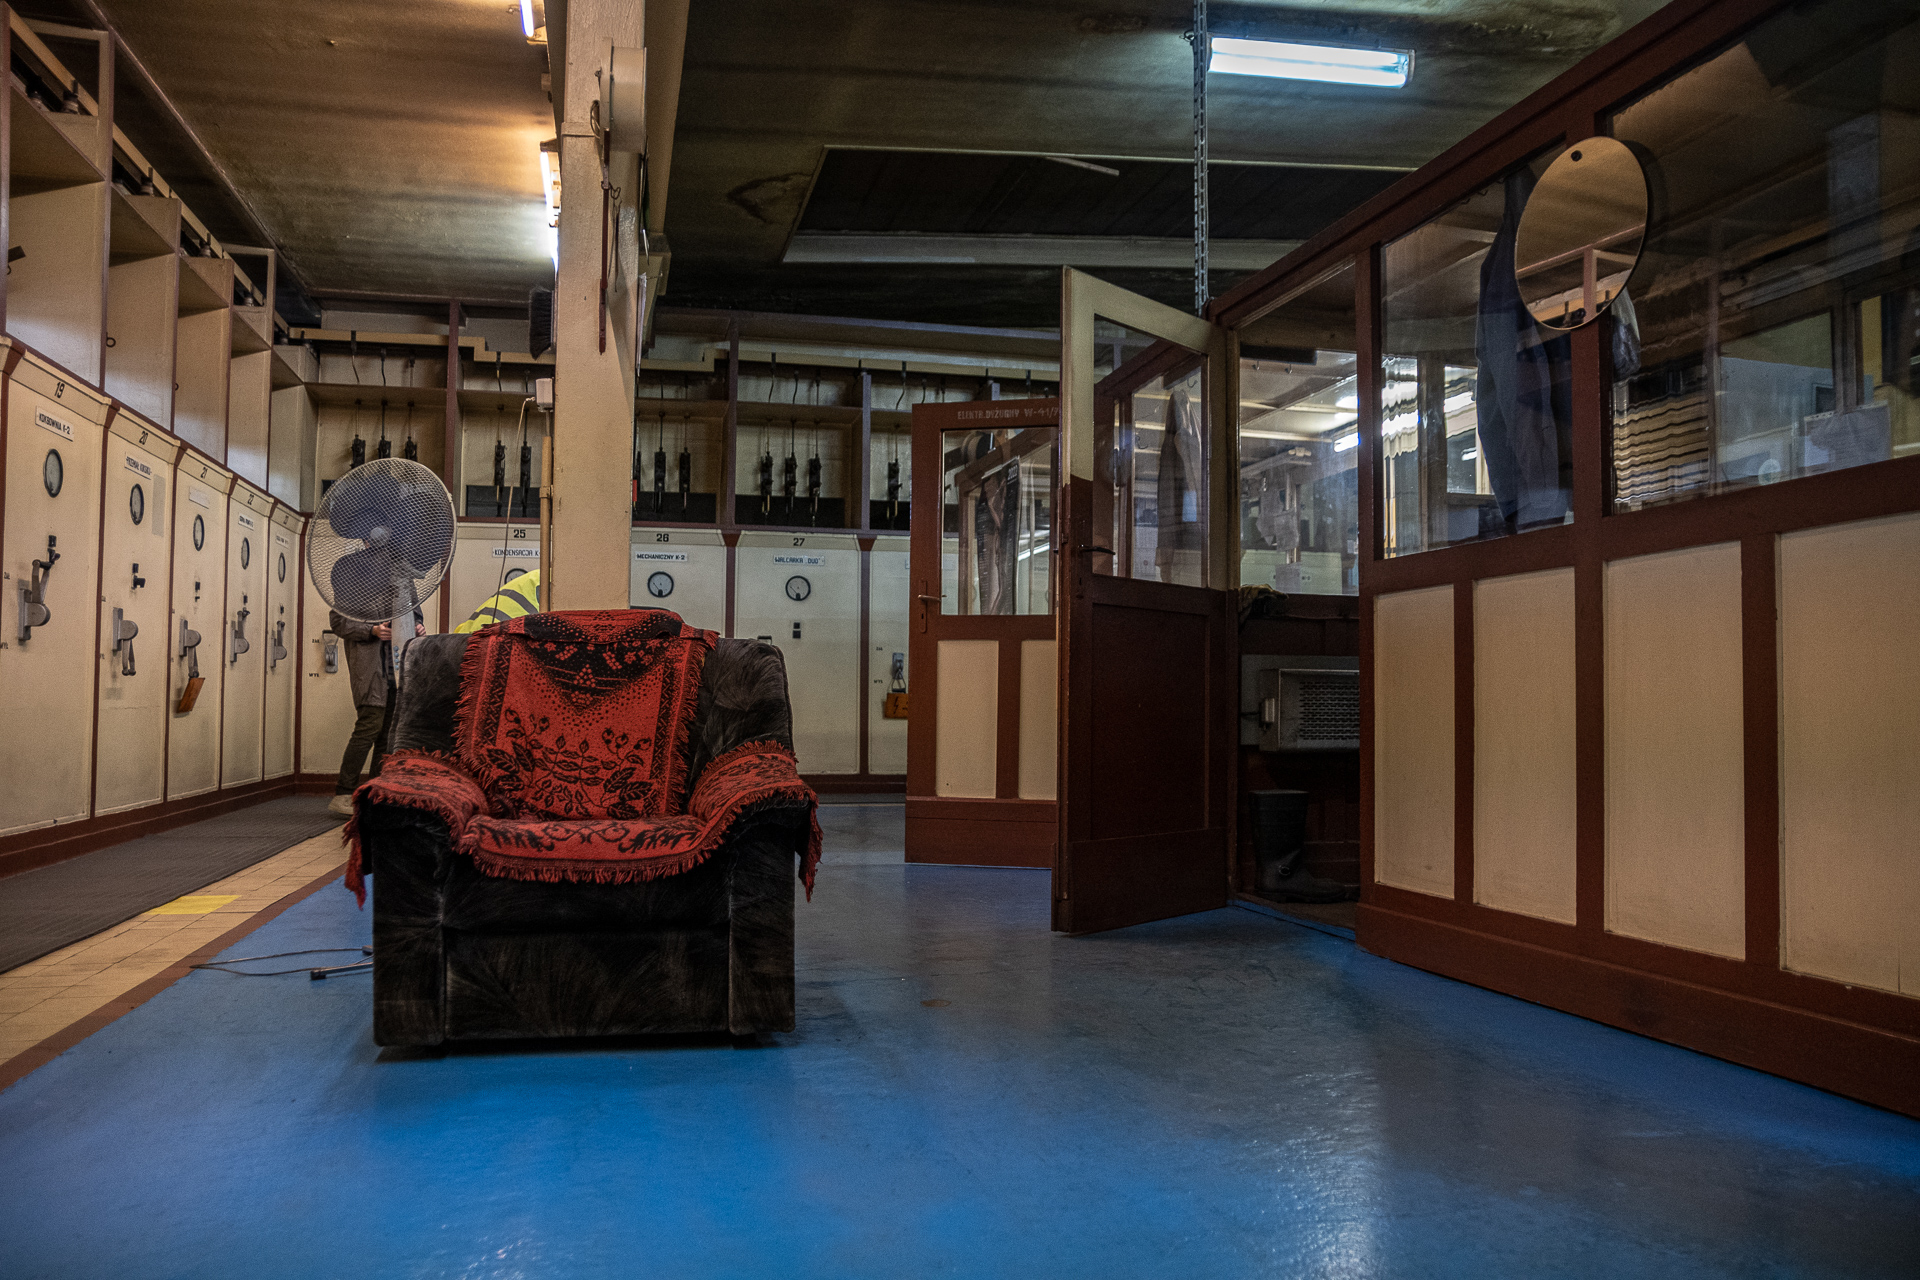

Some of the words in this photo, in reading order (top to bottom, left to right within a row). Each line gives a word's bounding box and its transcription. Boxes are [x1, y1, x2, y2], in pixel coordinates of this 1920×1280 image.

[54, 381, 66, 399] 19
[138, 430, 149, 446] 20
[200, 466, 208, 479] 21
[513, 529, 526, 539] 25
[656, 533, 670, 543] 26
[793, 537, 805, 547] 27
[774, 556, 804, 564] WALCARKA
